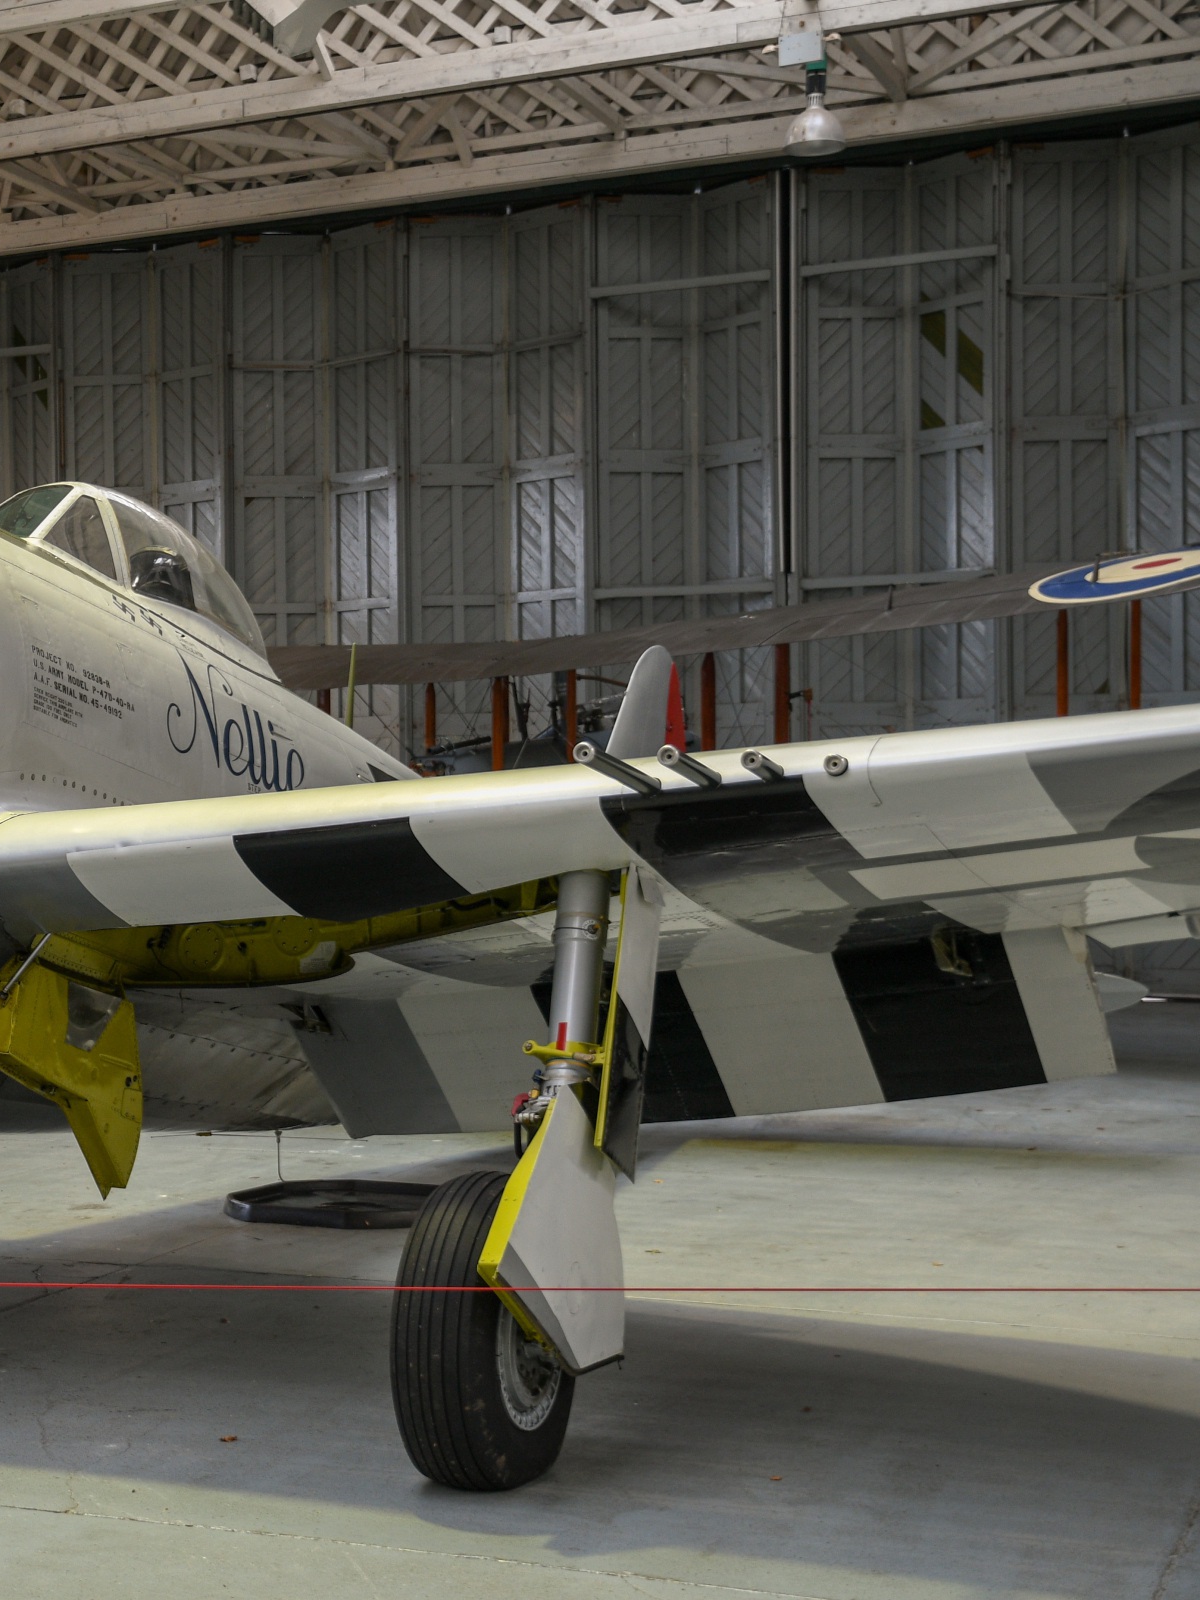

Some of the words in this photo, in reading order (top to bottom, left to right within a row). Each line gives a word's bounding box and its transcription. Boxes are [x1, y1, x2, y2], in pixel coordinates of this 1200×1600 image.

[32, 645, 61, 666] PROJECT
[66, 661, 76, 673] NO.
[33, 659, 46, 671] U.S.
[48, 666, 64, 679] ARMY
[68, 674, 88, 691] MODEL
[34, 671, 52, 687] A.A.F.
[54, 681, 77, 699] SERIAL
[79, 692, 89, 704] NO.
[167, 648, 304, 791] Nellie
